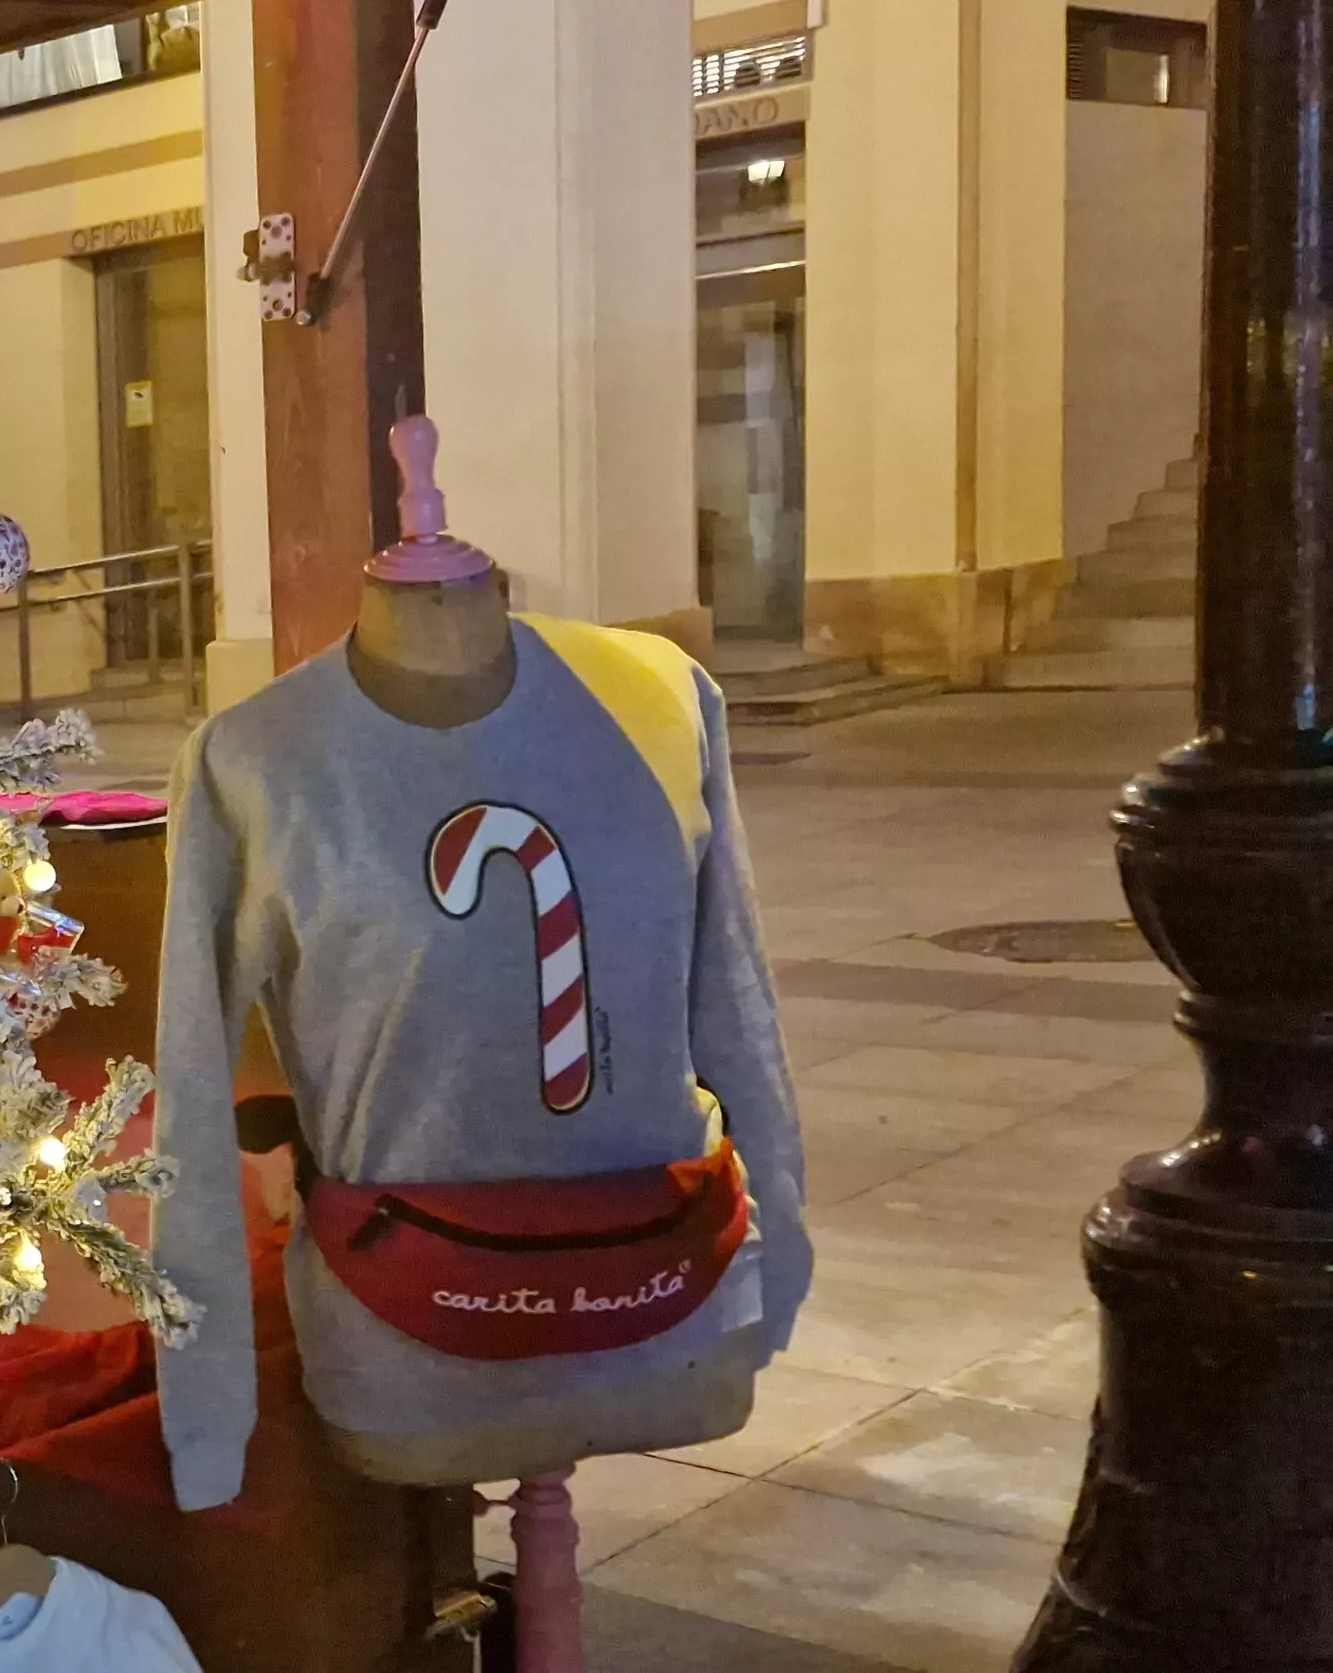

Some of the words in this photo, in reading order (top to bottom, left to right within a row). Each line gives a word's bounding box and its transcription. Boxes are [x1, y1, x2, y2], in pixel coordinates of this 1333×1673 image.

[72, 215, 168, 253] OFICINA
[173, 205, 202, 235] M
[432, 1287, 557, 1314] carita
[570, 1270, 685, 1312] bonita
